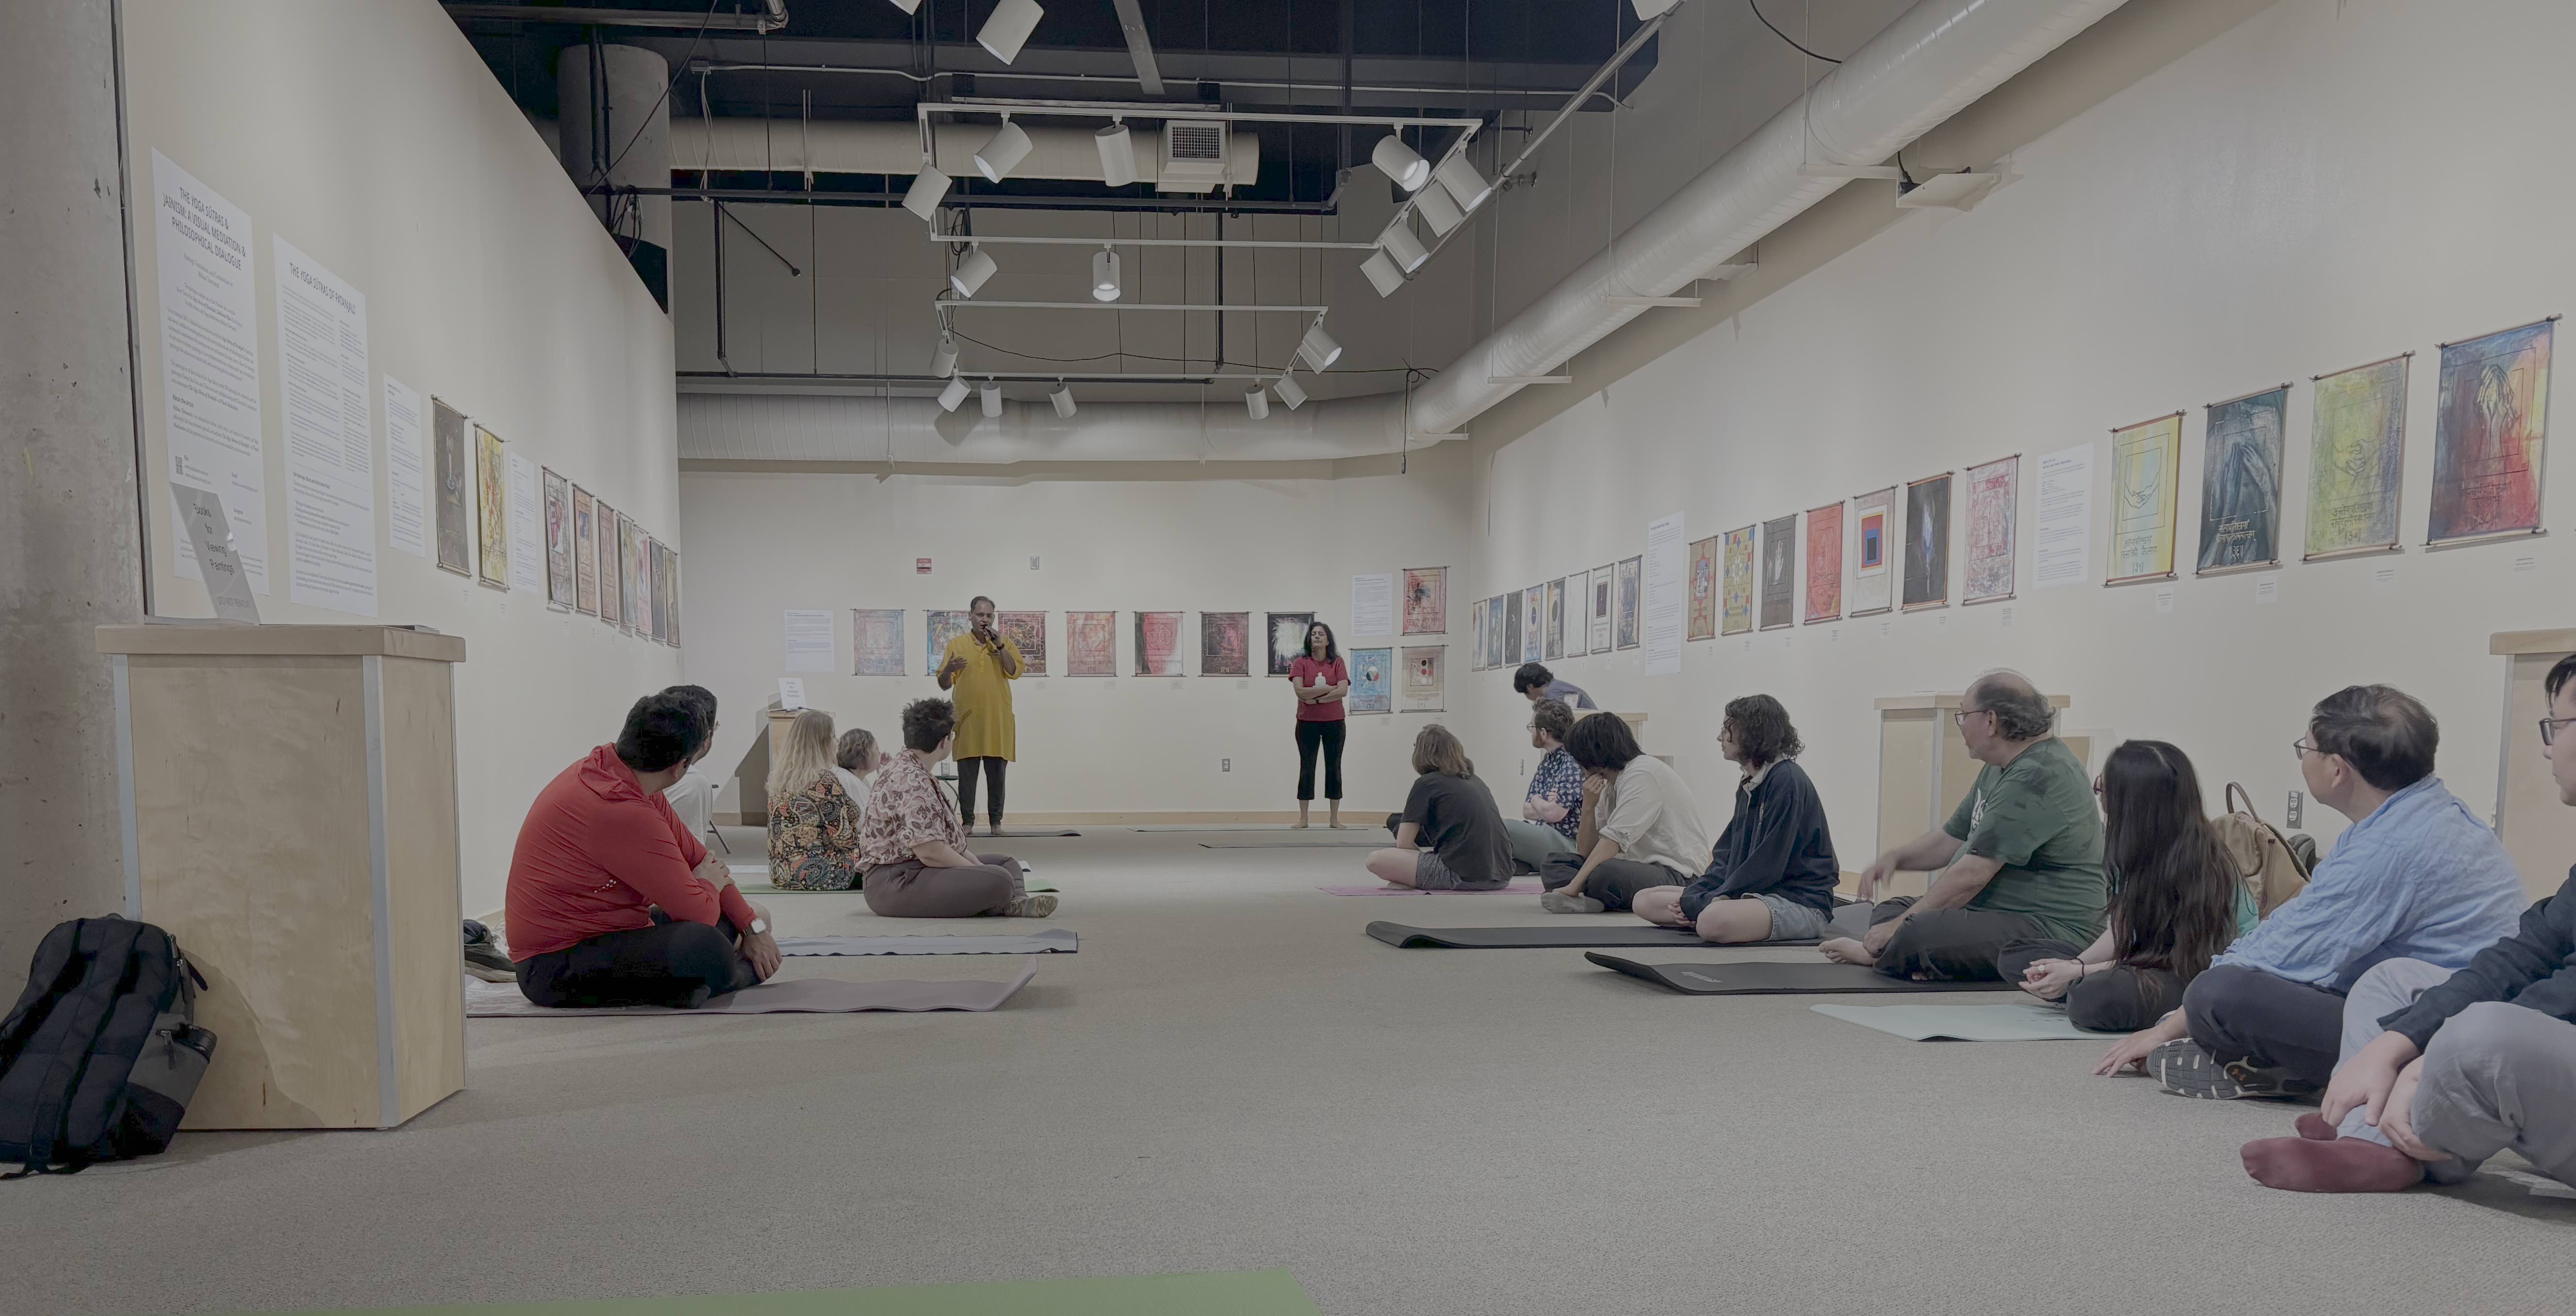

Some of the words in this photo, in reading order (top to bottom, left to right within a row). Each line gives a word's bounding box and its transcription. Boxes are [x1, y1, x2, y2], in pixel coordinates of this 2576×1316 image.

[179, 187, 190, 204] THE
[191, 195, 204, 214] YOGA
[225, 218, 229, 230] &
[163, 193, 187, 218] JAINISM:
[188, 210, 192, 222] A
[192, 213, 211, 235] VISUAL
[212, 226, 241, 254] MEDIATION
[242, 246, 245, 257] &
[172, 216, 214, 254] PHILOSOPHICAL
[215, 245, 241, 271] DIALOGUE
[290, 263, 299, 278] THE
[301, 271, 312, 286] YOGA
[193, 503, 212, 517] Books
[205, 541, 227, 558] Viewing
[210, 559, 234, 576] Paintings
